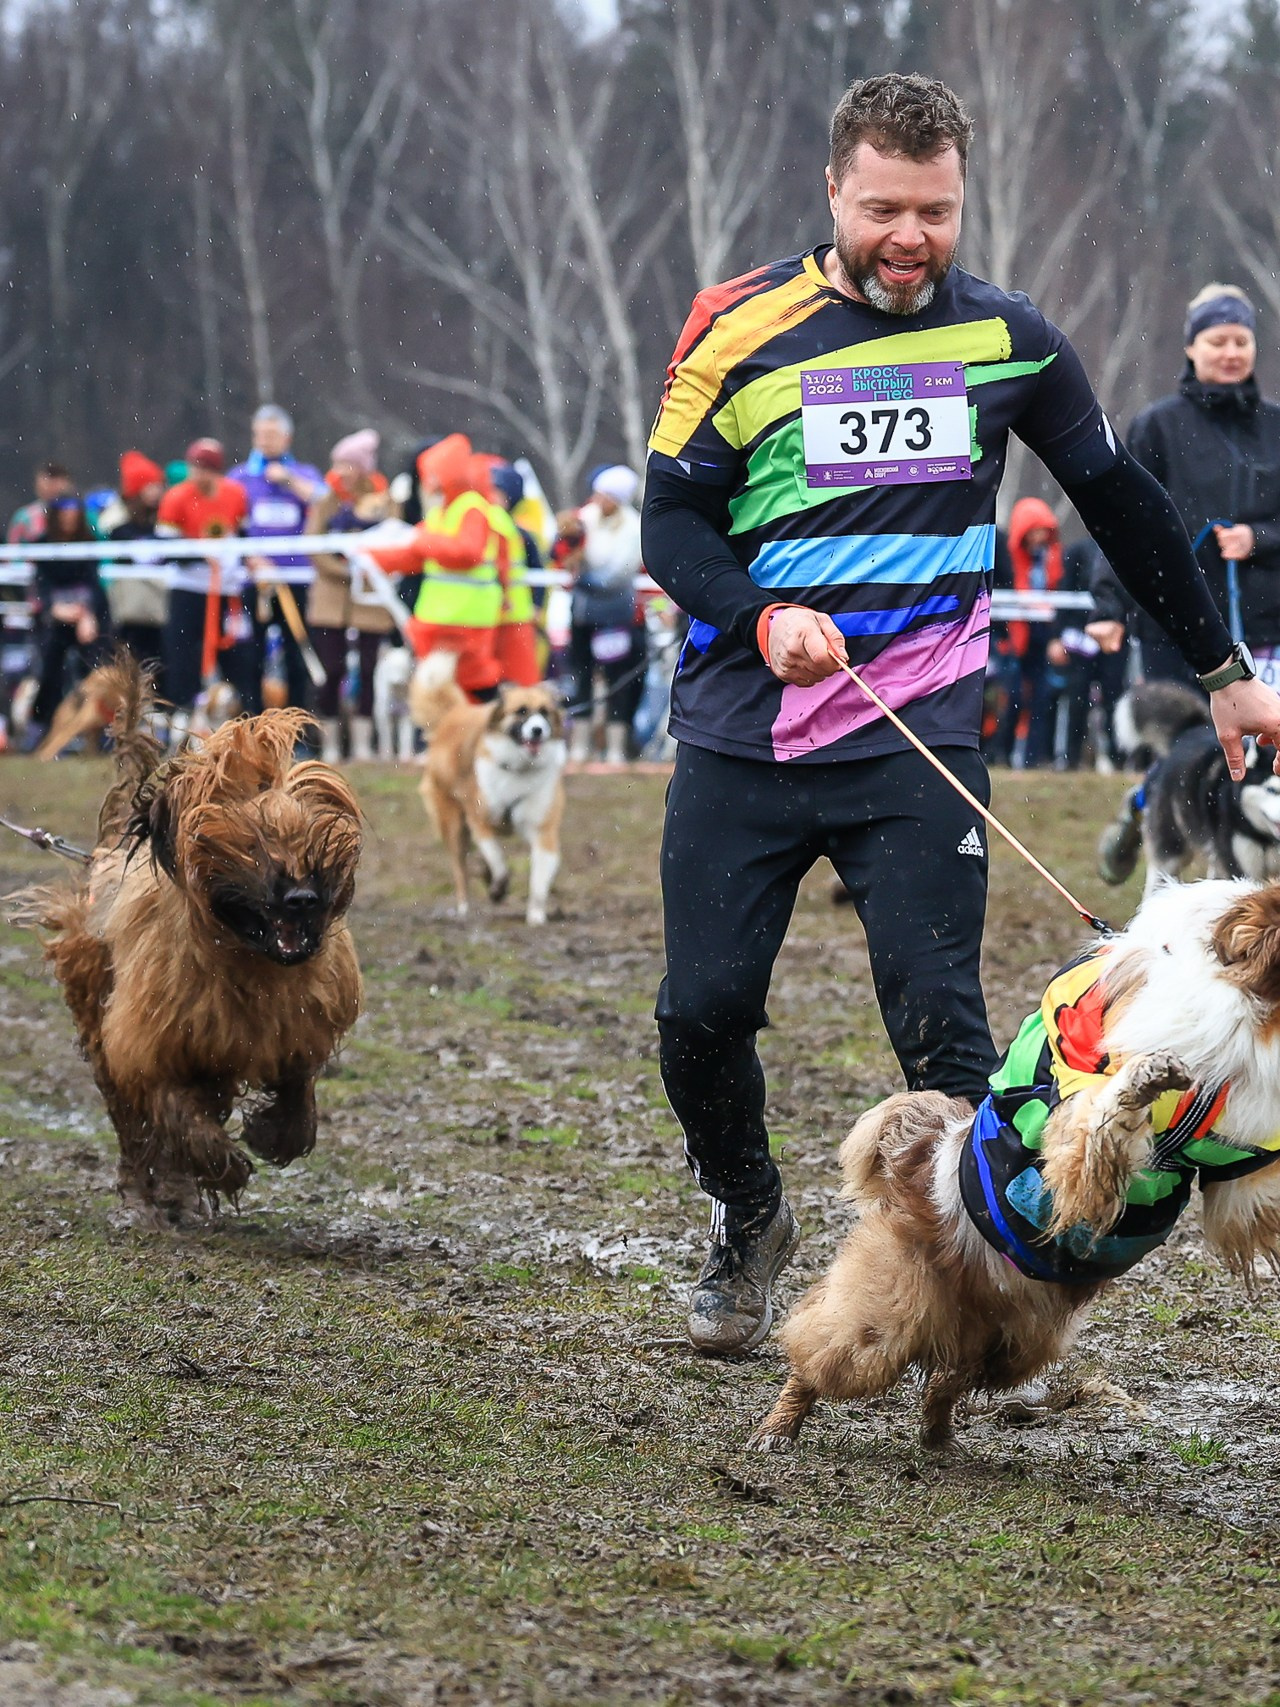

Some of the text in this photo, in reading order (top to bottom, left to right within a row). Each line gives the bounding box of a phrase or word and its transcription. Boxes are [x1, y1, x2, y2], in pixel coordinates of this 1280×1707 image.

[807, 374, 843, 385] 11/04
[852, 366, 900, 380] КРОСС
[852, 376, 913, 392] БЫСТРЫЙ
[924, 376, 933, 386] 2
[808, 384, 844, 395] 2026
[839, 407, 931, 455] 373
[957, 844, 984, 858] adidas
